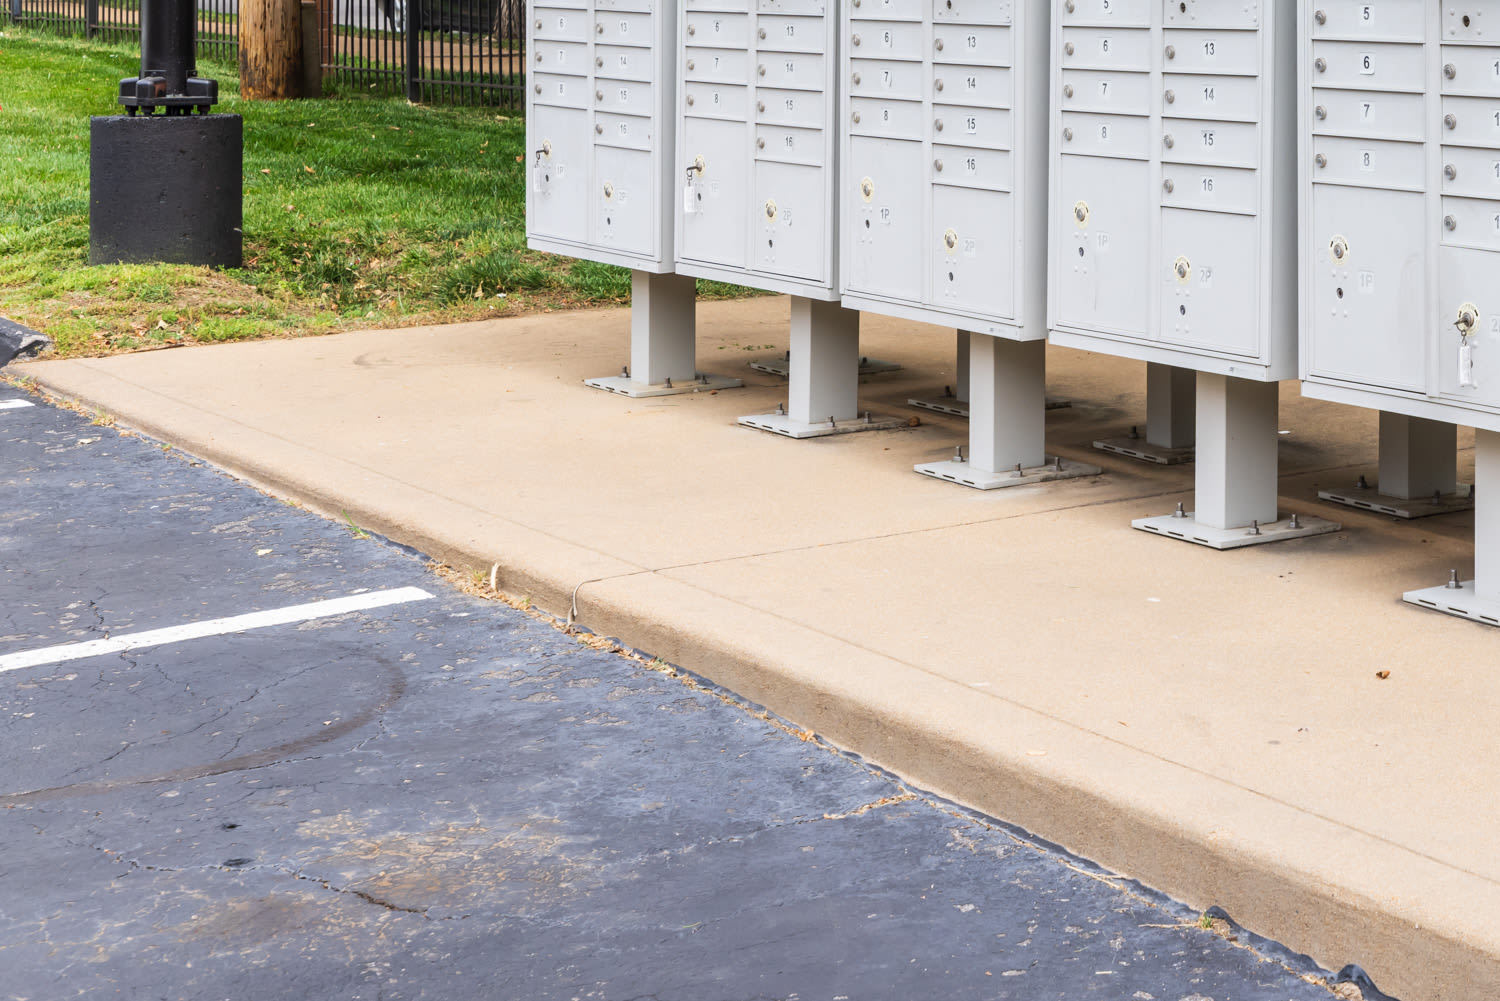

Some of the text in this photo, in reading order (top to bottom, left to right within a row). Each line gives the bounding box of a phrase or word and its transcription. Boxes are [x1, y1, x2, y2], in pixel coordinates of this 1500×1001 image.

[1363, 6, 1370, 21] 5
[714, 21, 720, 33] 6
[786, 25, 794, 37] 13
[884, 31, 890, 44] 6
[967, 35, 977, 48] 13
[1102, 39, 1109, 53] 6
[1204, 42, 1215, 56] 13
[714, 56, 720, 69] 7
[785, 62, 794, 73] 14
[1363, 55, 1370, 70] 6
[884, 70, 890, 83] 7
[966, 76, 976, 89] 14
[1102, 82, 1108, 95] 7
[1203, 87, 1215, 101] 14
[714, 92, 719, 104] 8
[785, 98, 794, 111] 15
[883, 109, 889, 122] 8
[1363, 103, 1371, 118] 7
[966, 117, 976, 130] 15
[1101, 125, 1108, 139] 8
[785, 136, 794, 148] 16
[1202, 132, 1214, 146] 15
[966, 158, 976, 171] 16
[1363, 152, 1370, 167] 8
[1202, 178, 1214, 192] 16
